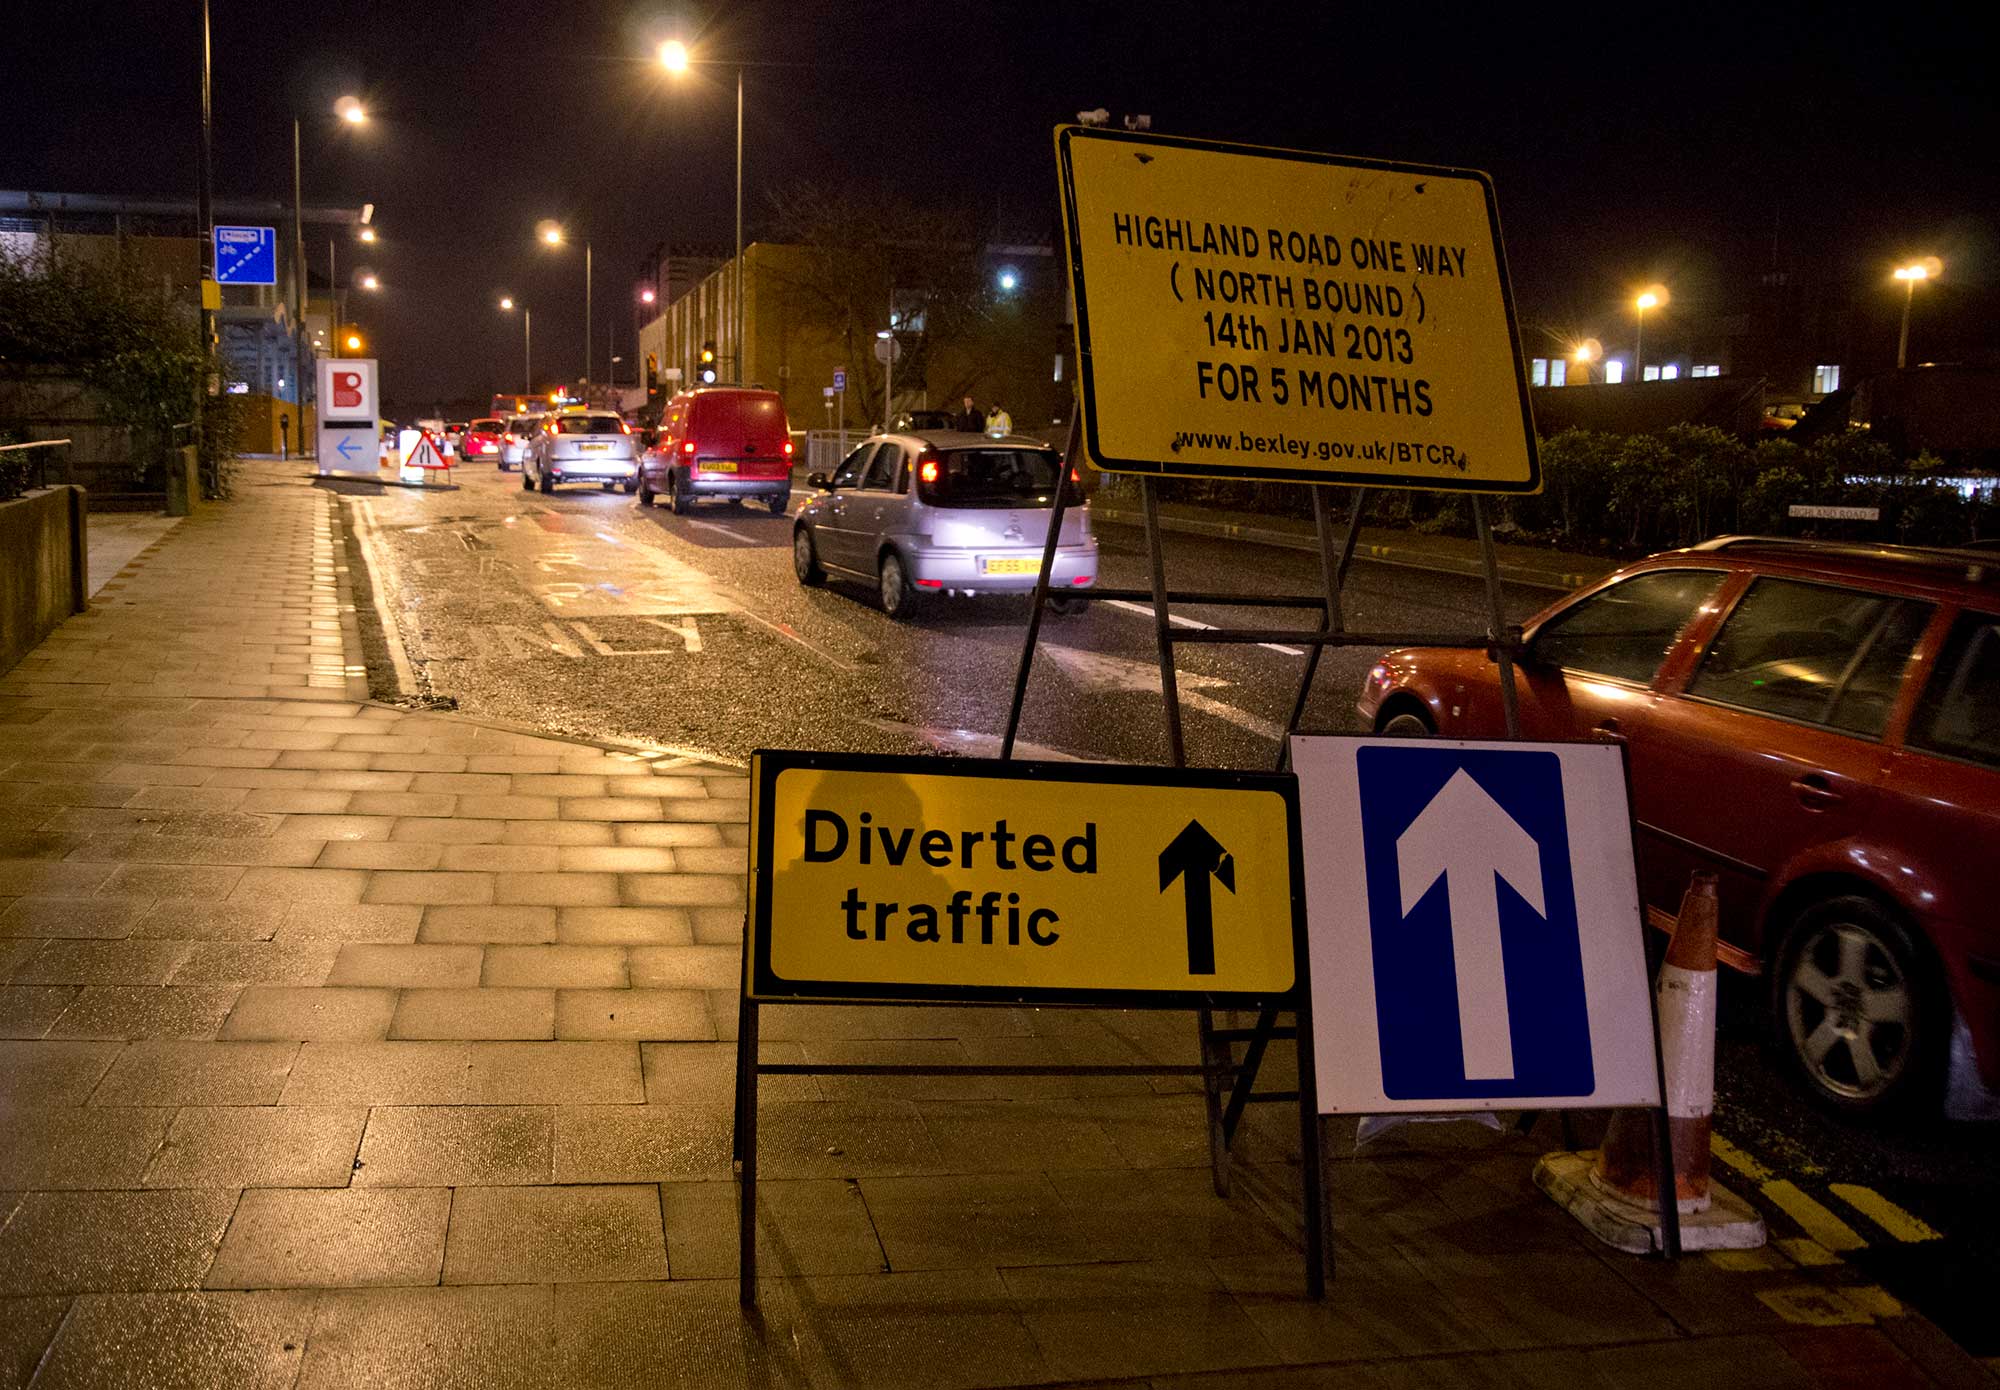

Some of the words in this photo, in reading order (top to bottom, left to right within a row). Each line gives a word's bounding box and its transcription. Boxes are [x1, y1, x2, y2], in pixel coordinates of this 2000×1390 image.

[1114, 213, 1260, 258] HIGHLAND
[1268, 229, 1342, 267] ROAD
[1350, 237, 1407, 273] ONE
[1411, 244, 1466, 278] WAY
[1204, 311, 1268, 352] 14th
[1278, 318, 1335, 358] JAN
[1344, 324, 1414, 365] 2013
[1198, 361, 1262, 403] FOR
[1271, 368, 1290, 406] 5
[1299, 370, 1434, 417] MONTHS
[1174, 431, 1457, 466] www.bexley.gov.uk/BTCR
[1839, 509, 1867, 520] ROAD
[804, 809, 1097, 874] Diverted
[841, 888, 1060, 947] traffic
